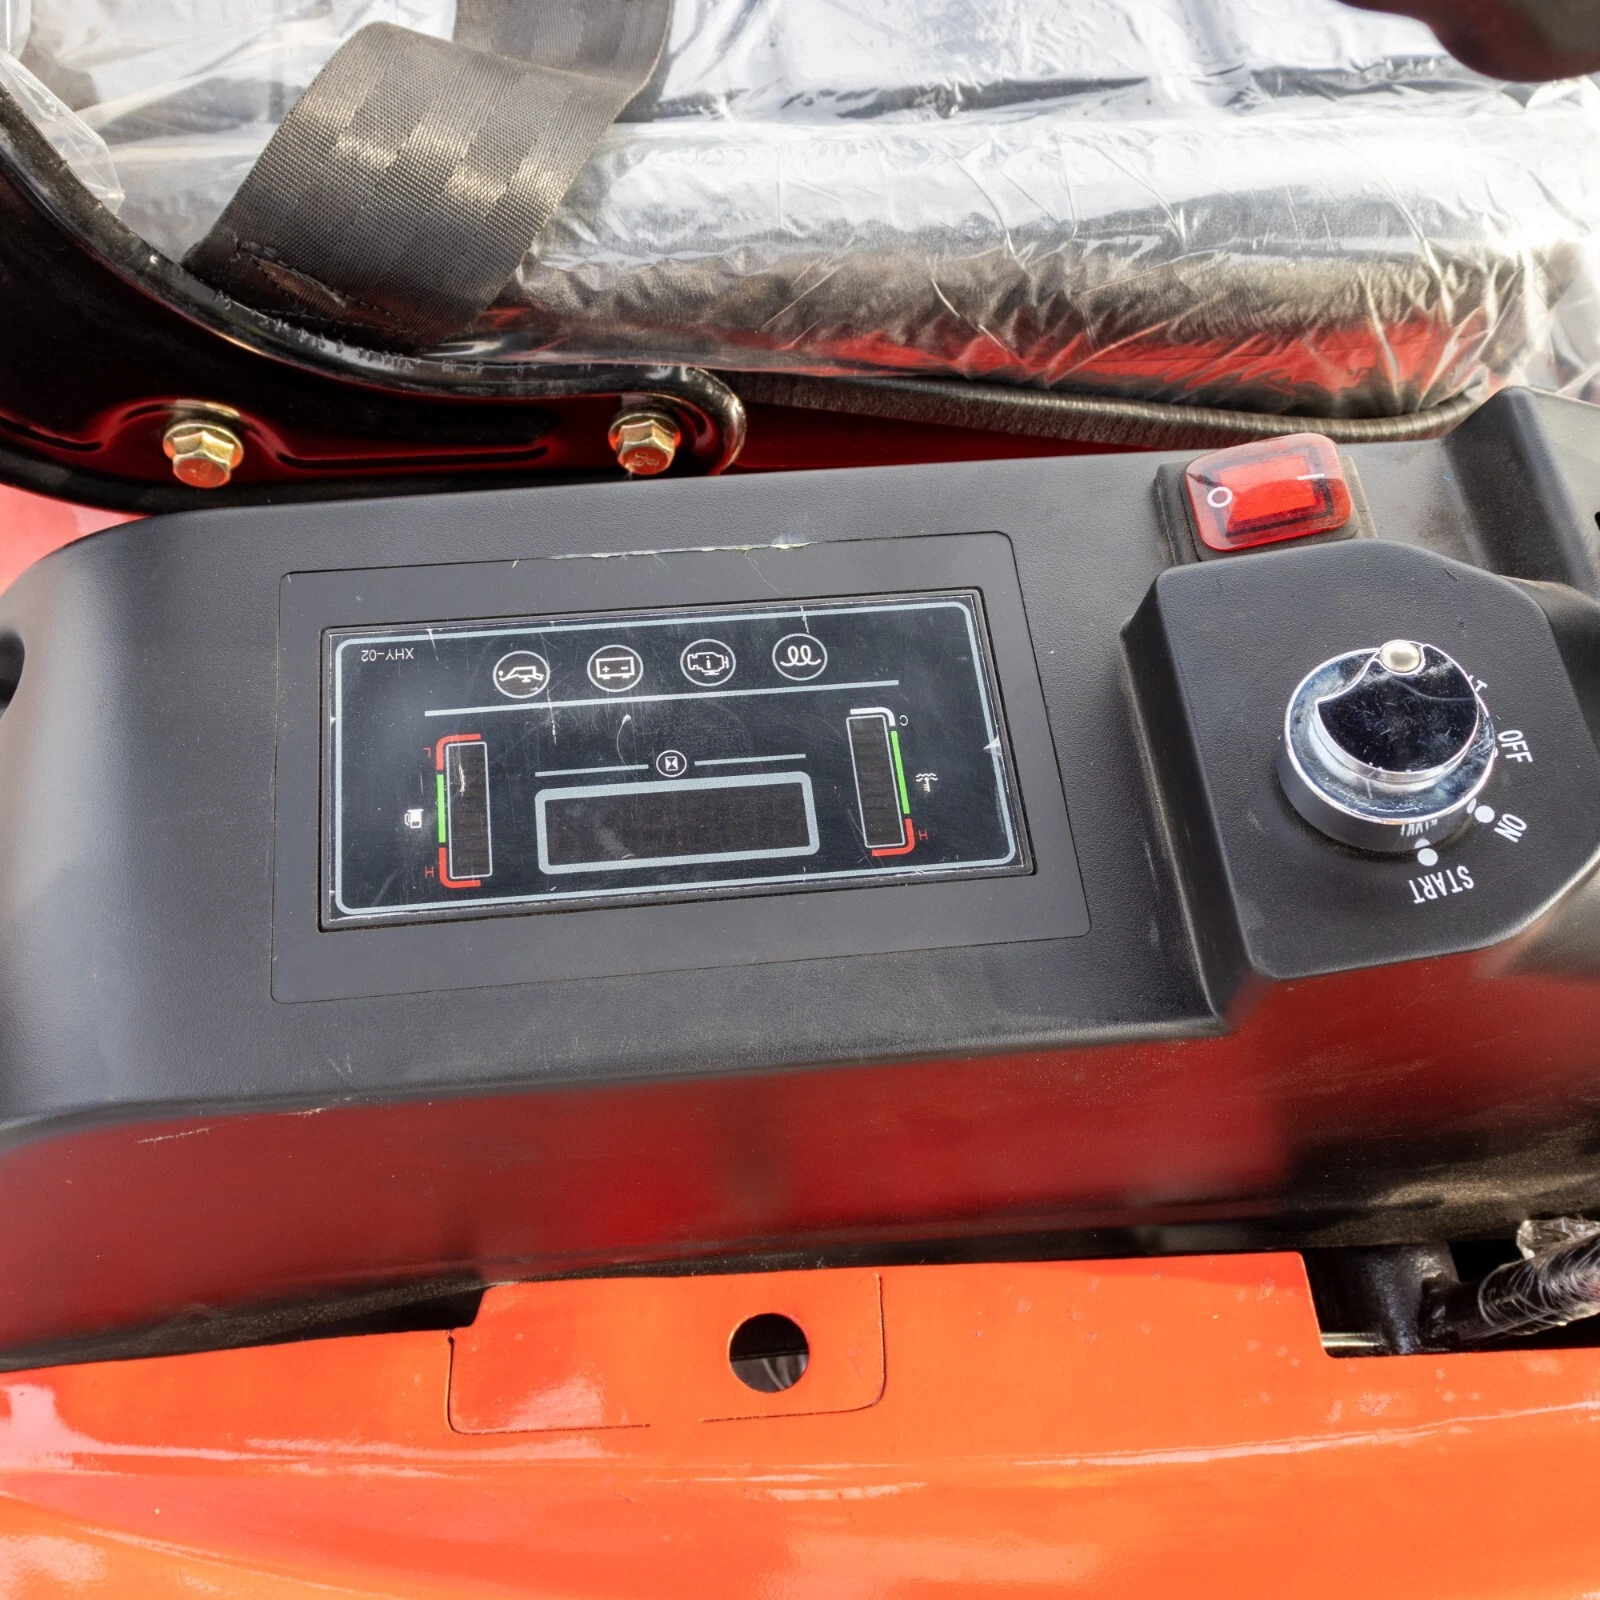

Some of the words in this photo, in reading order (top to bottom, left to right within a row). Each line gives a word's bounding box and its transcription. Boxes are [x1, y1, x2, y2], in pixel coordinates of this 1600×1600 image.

[361, 647, 415, 662] XHY-02
[1497, 729, 1534, 763] OFF
[917, 829, 928, 841] H
[1493, 813, 1527, 843] ON
[424, 866, 435, 878] H
[1408, 865, 1475, 904] START
